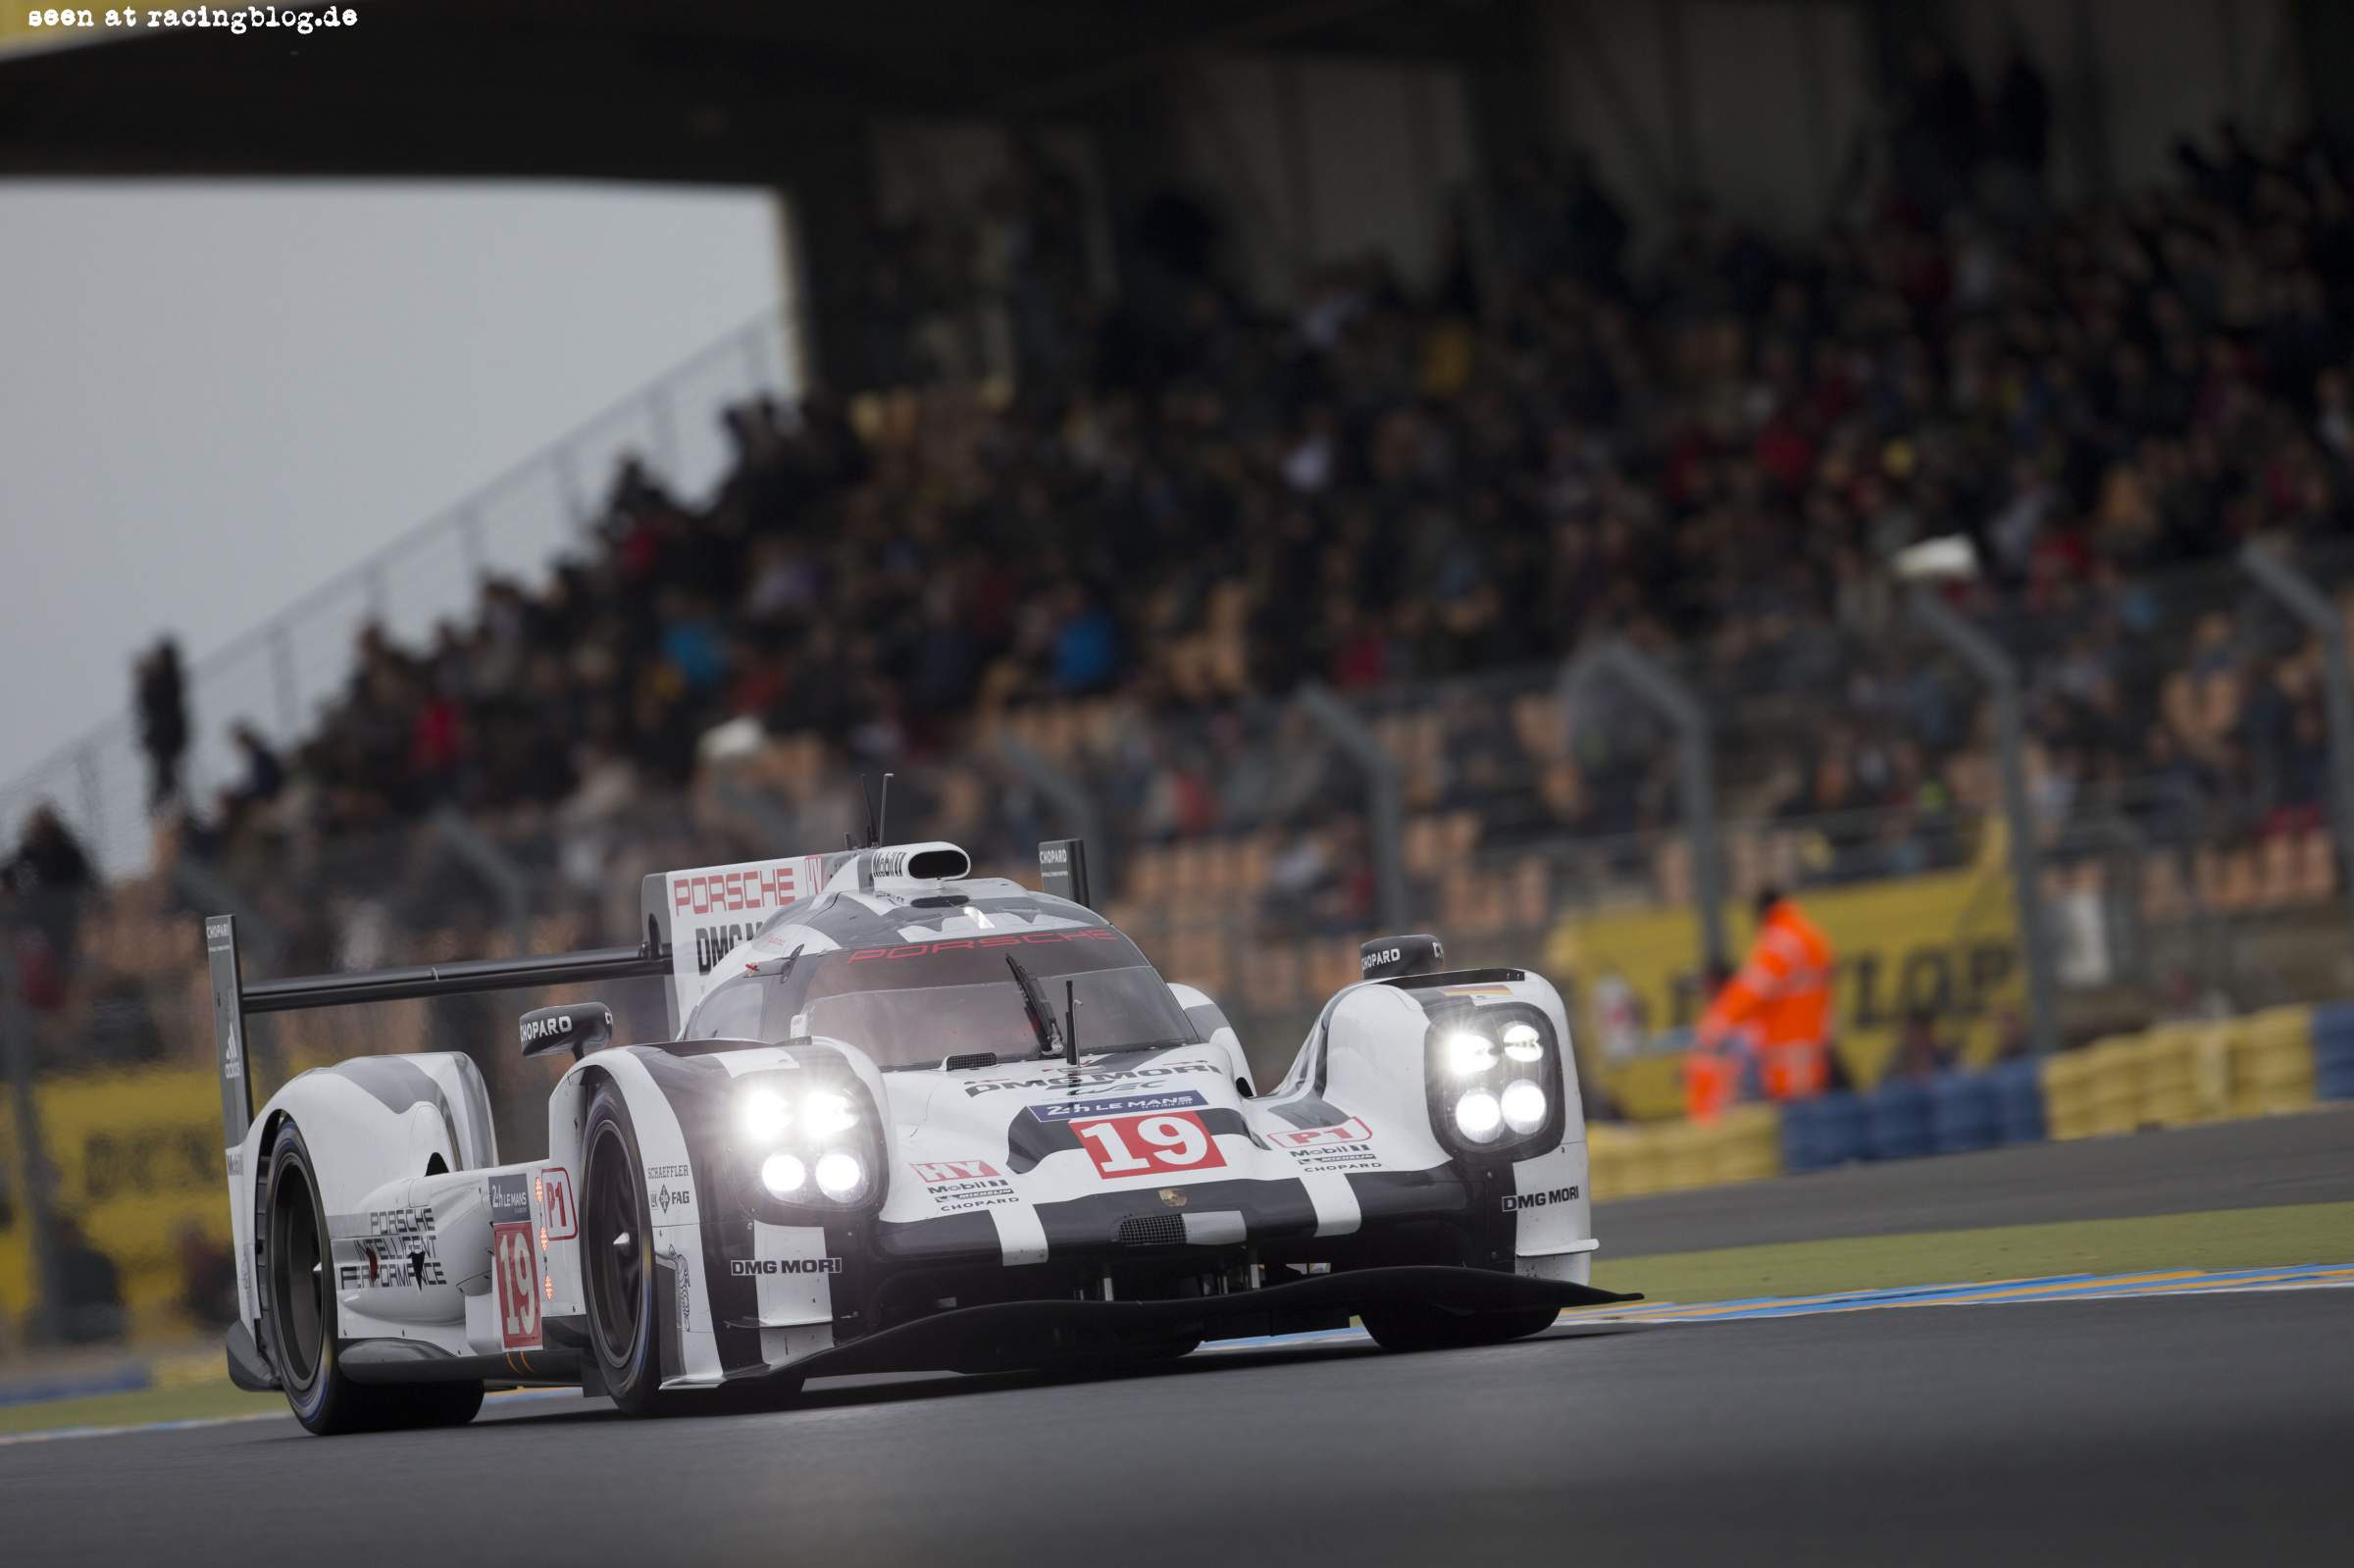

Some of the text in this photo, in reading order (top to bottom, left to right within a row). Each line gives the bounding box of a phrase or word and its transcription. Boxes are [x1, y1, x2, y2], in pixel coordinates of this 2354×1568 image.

[873, 852, 895, 878] Mobil
[1039, 849, 1067, 864] CHOPARD
[674, 867, 795, 917] PORSCHE
[847, 929, 1119, 965] PORSCHE
[964, 1064, 1222, 1097] DMG MORI
[1096, 1102, 1123, 1112] LE
[1128, 1096, 1194, 1108] MANS
[1287, 1127, 1354, 1144] P1
[1080, 1116, 1208, 1174] 19
[1290, 1145, 1348, 1157] Mobil
[647, 1164, 690, 1180] SCHAEFFLER
[912, 1161, 986, 1181] HY
[1305, 1163, 1382, 1173] CHOPARD
[927, 1181, 987, 1194] Mobil
[503, 1193, 511, 1207] LE
[511, 1191, 527, 1207] MANS
[546, 1181, 567, 1229] P1
[672, 1190, 691, 1205] FAG
[941, 1197, 1019, 1212] CHOPARD
[1503, 1186, 1579, 1211] DMG MORI
[370, 1207, 435, 1235] PORSCHE
[732, 1259, 842, 1275] DMG MORI
[498, 1232, 537, 1337] 19
